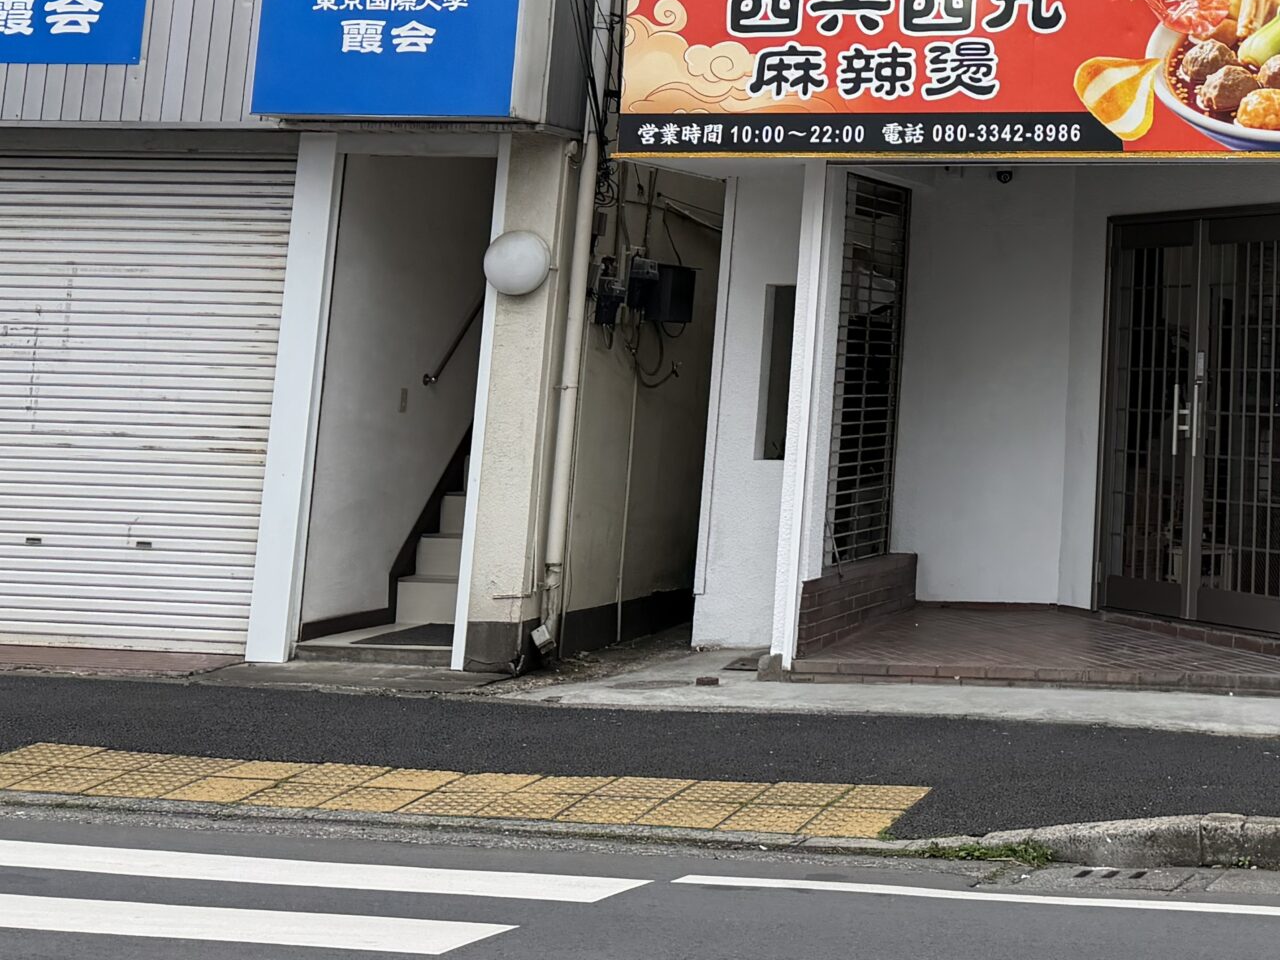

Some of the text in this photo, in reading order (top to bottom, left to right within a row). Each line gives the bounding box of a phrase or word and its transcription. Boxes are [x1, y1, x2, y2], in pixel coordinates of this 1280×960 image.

[340, 19, 437, 54] 霞会
[637, 122, 723, 146] 営業時間
[881, 124, 925, 145] 電話
[932, 123, 1082, 143] 080-3342-8986
